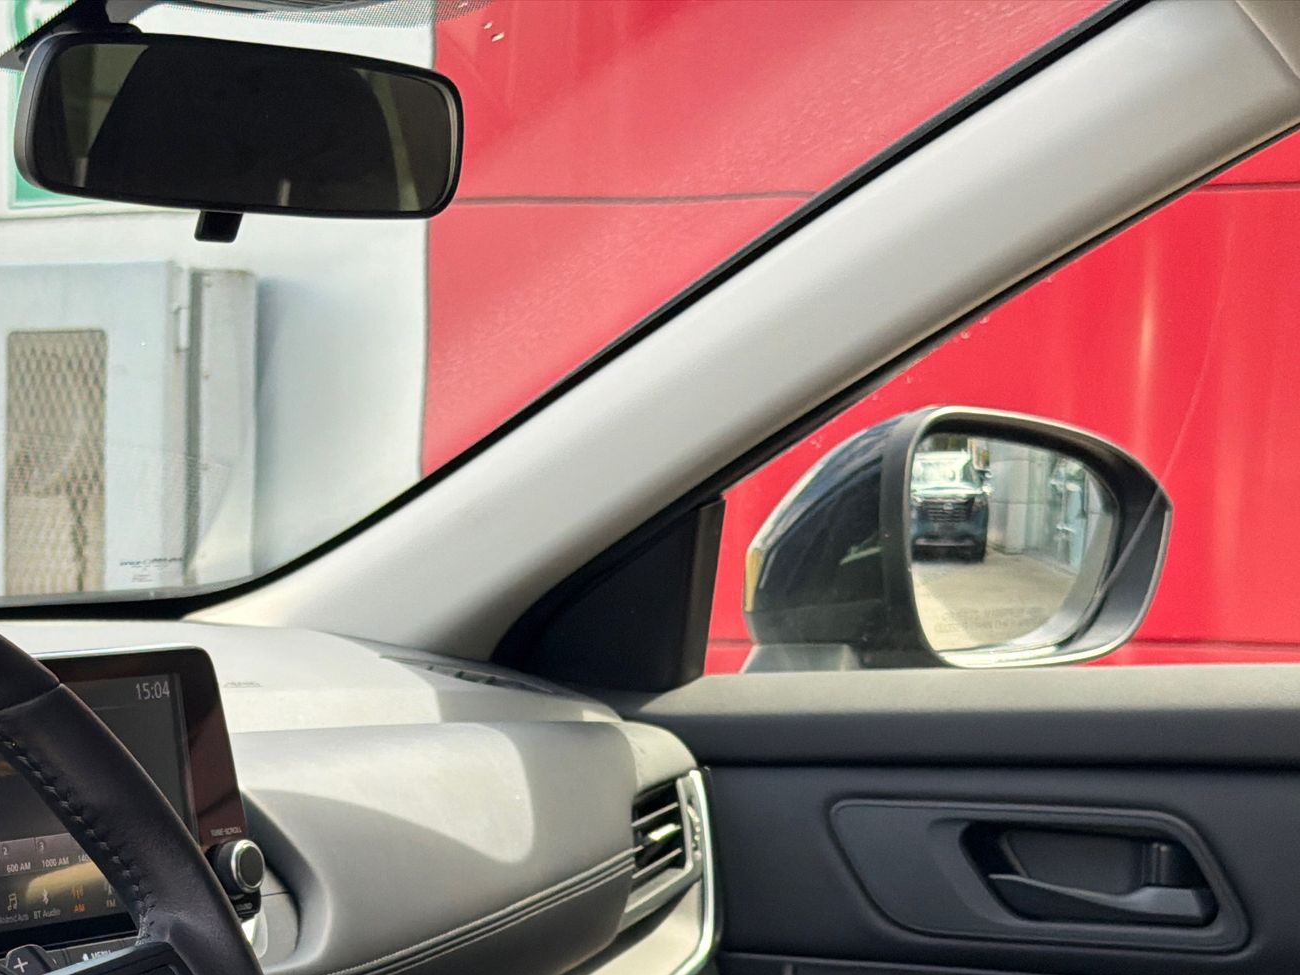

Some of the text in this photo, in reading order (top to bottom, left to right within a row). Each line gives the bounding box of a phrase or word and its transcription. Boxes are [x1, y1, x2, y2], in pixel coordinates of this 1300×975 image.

[135, 680, 170, 700] 15:04
[3, 847, 8, 856] 2
[40, 841, 45, 851] 3
[6, 861, 31, 873] 600 AM
[41, 857, 70, 868] 1000 AM
[33, 908, 61, 920] BT Audio
[73, 904, 86, 913] AM
